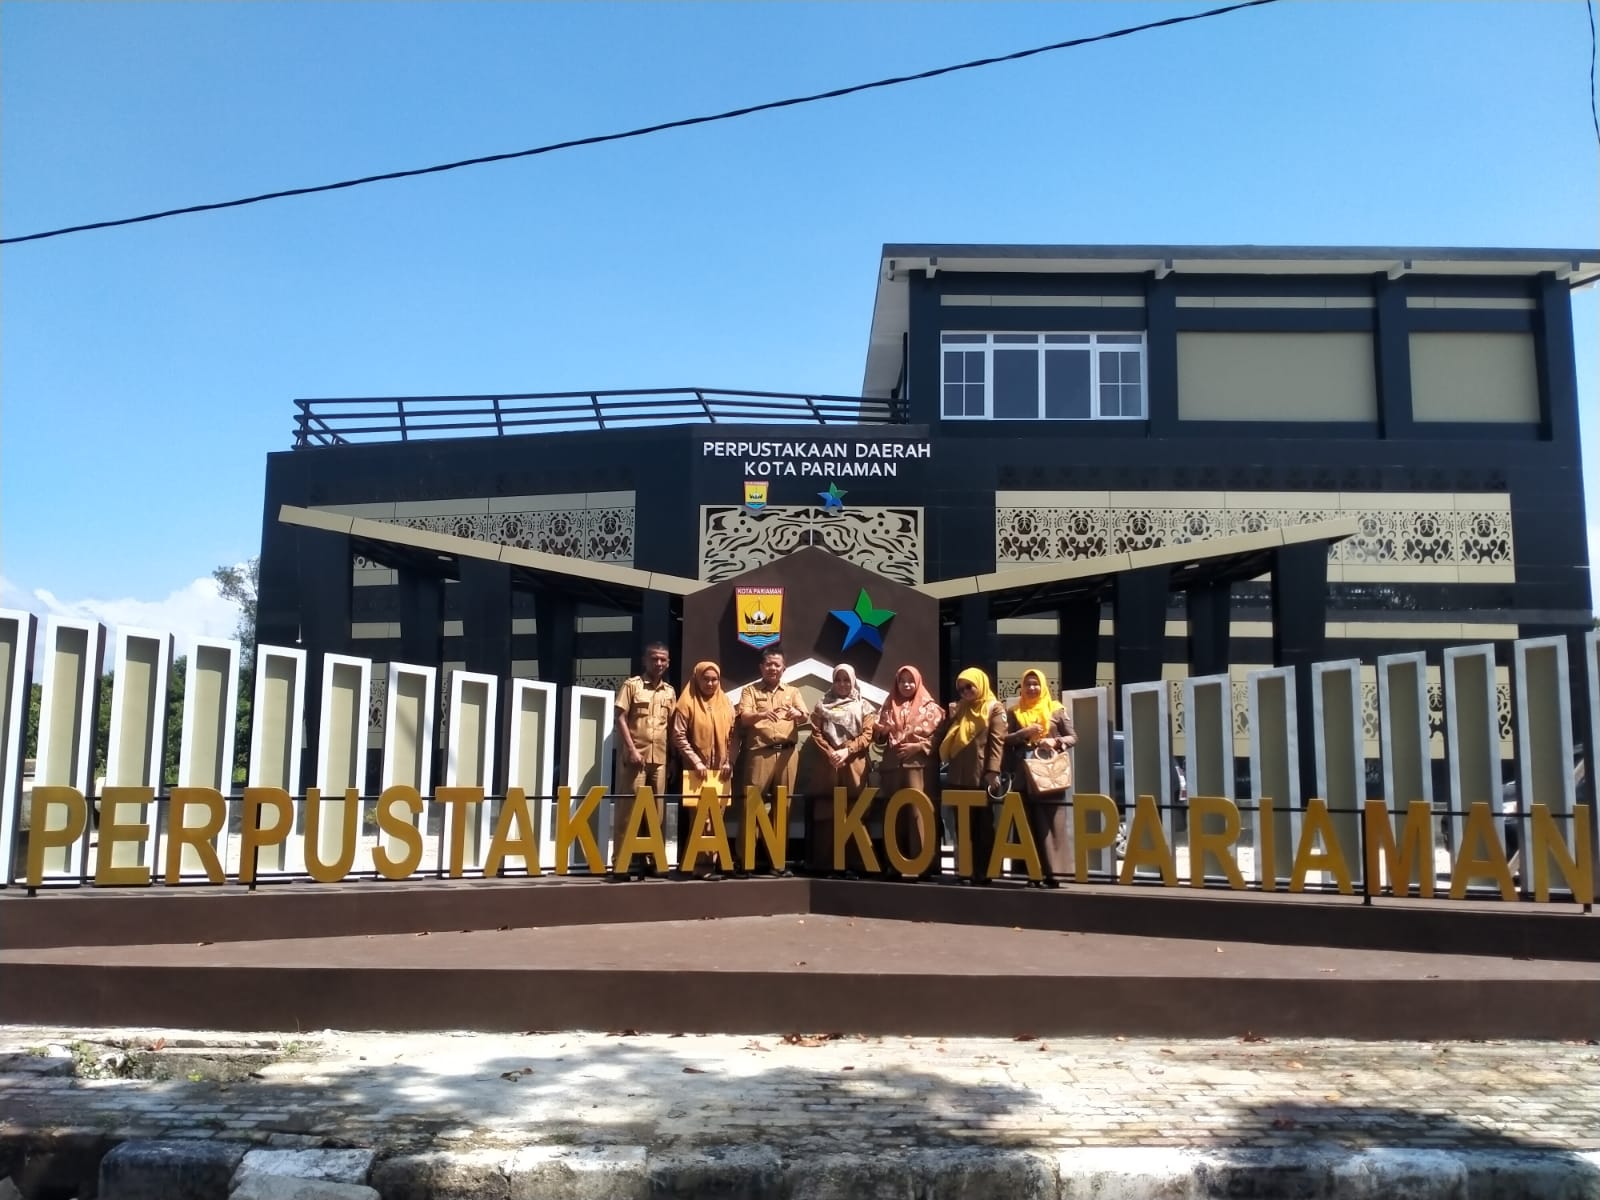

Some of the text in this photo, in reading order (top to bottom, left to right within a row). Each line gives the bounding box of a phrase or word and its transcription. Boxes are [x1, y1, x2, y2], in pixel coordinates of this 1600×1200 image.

[703, 441, 931, 458] PERPUSTAKAAN DAERAH
[744, 461, 897, 477] KOTA PARIAMAN
[26, 785, 1594, 904] PERPUSTAKAAN KOTA PARIAMAN
